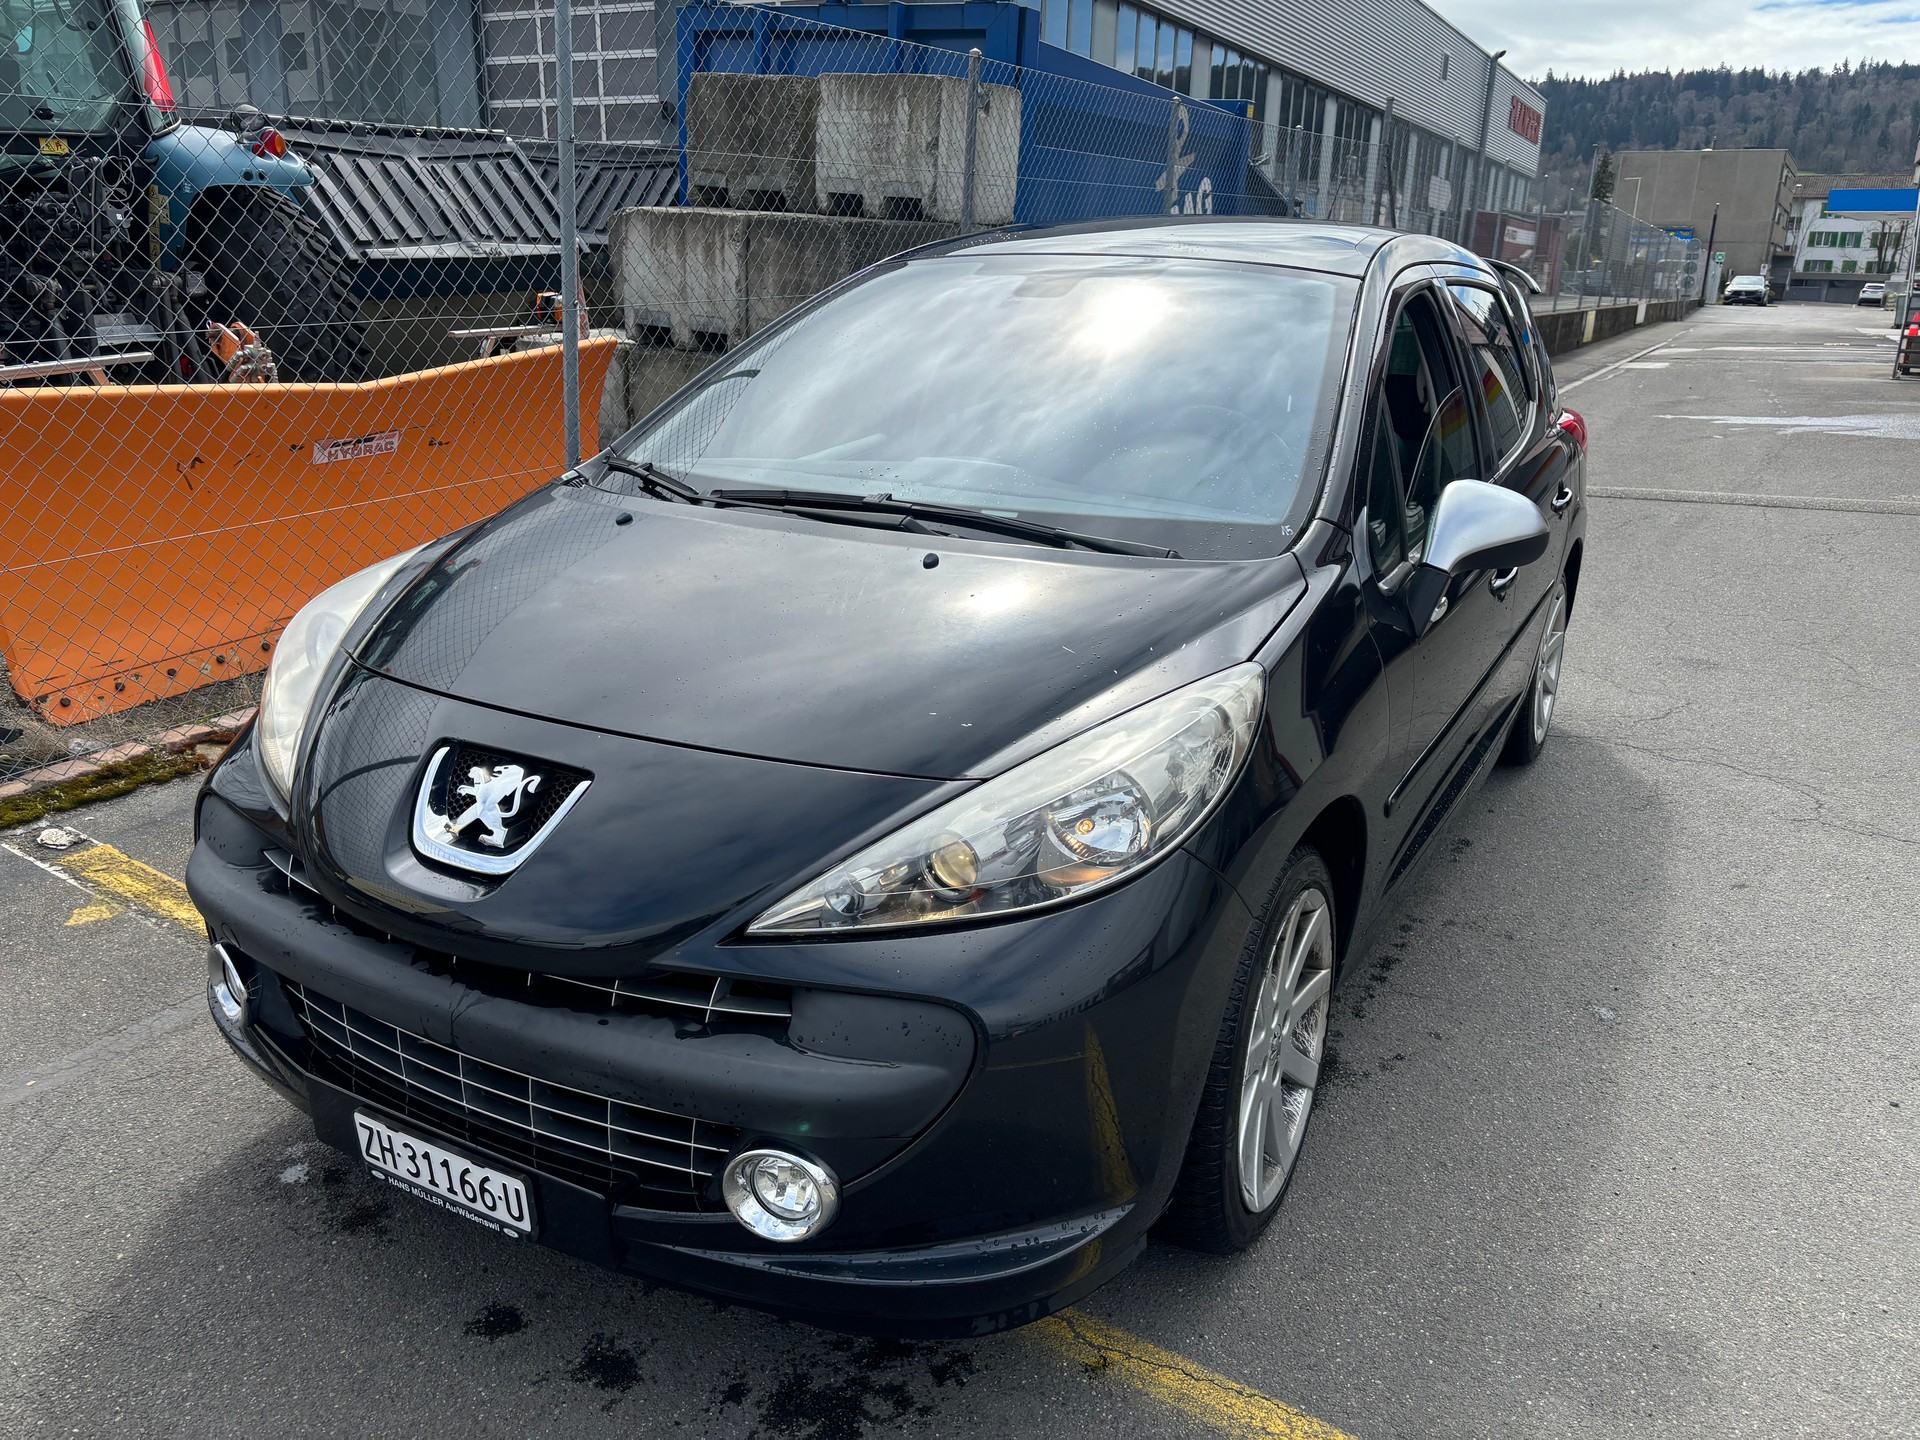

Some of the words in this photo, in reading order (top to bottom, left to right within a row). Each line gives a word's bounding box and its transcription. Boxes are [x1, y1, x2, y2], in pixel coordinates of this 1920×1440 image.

[328, 441, 394, 460] HYDRAC
[388, 1176, 410, 1192] HANS
[411, 1188, 444, 1207] MÜLLER
